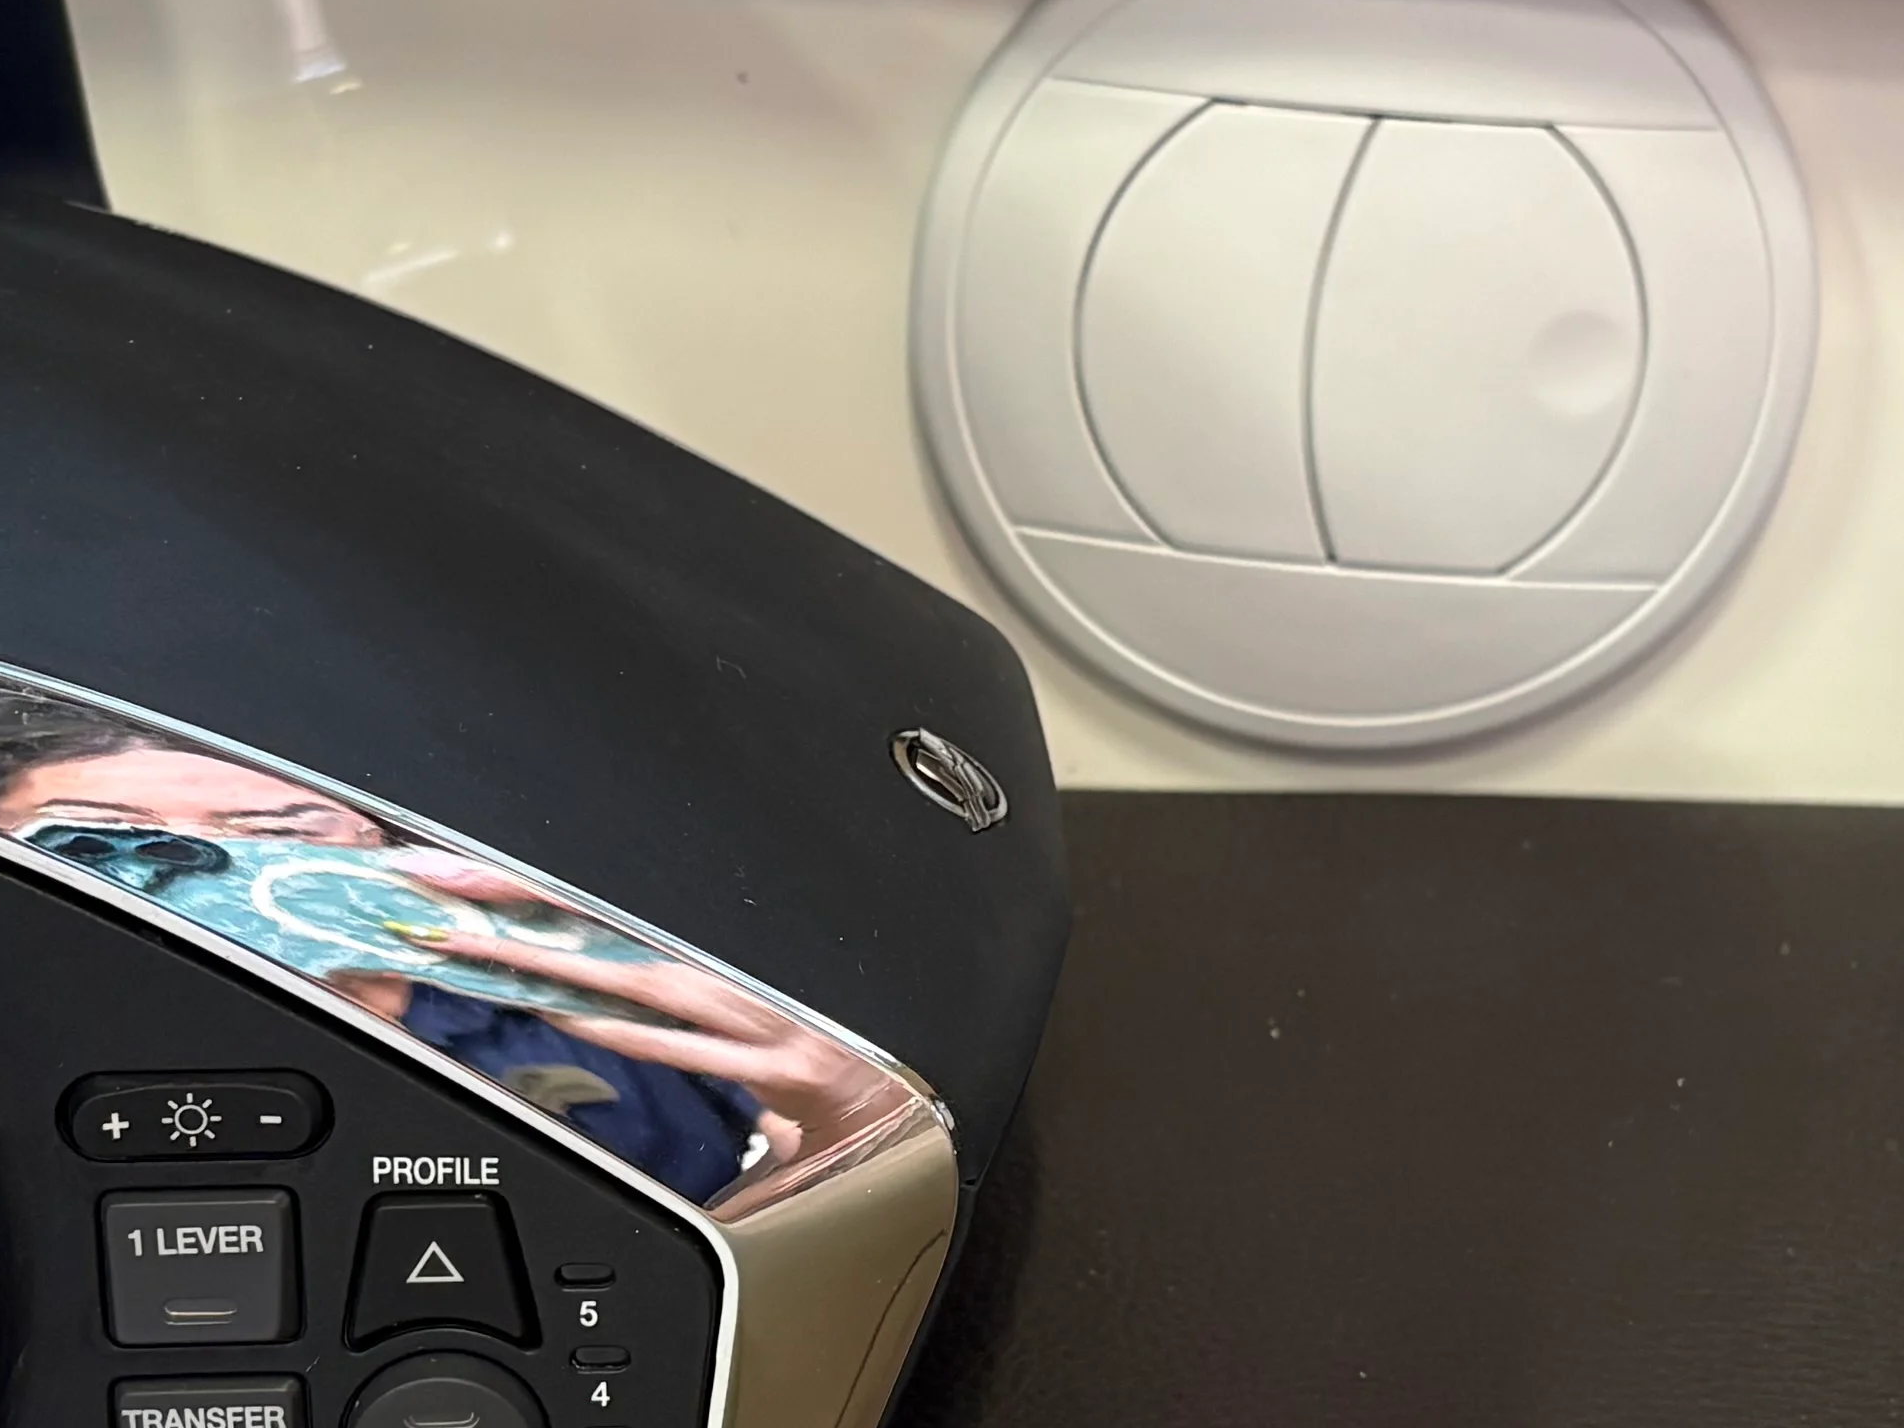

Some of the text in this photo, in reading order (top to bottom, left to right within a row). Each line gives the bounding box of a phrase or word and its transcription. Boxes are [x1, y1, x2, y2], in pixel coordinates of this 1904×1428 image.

[372, 1157, 499, 1186] PROFILE
[128, 1226, 264, 1256] 1 LEVER
[579, 1301, 598, 1328] 5
[591, 1382, 610, 1408] 4
